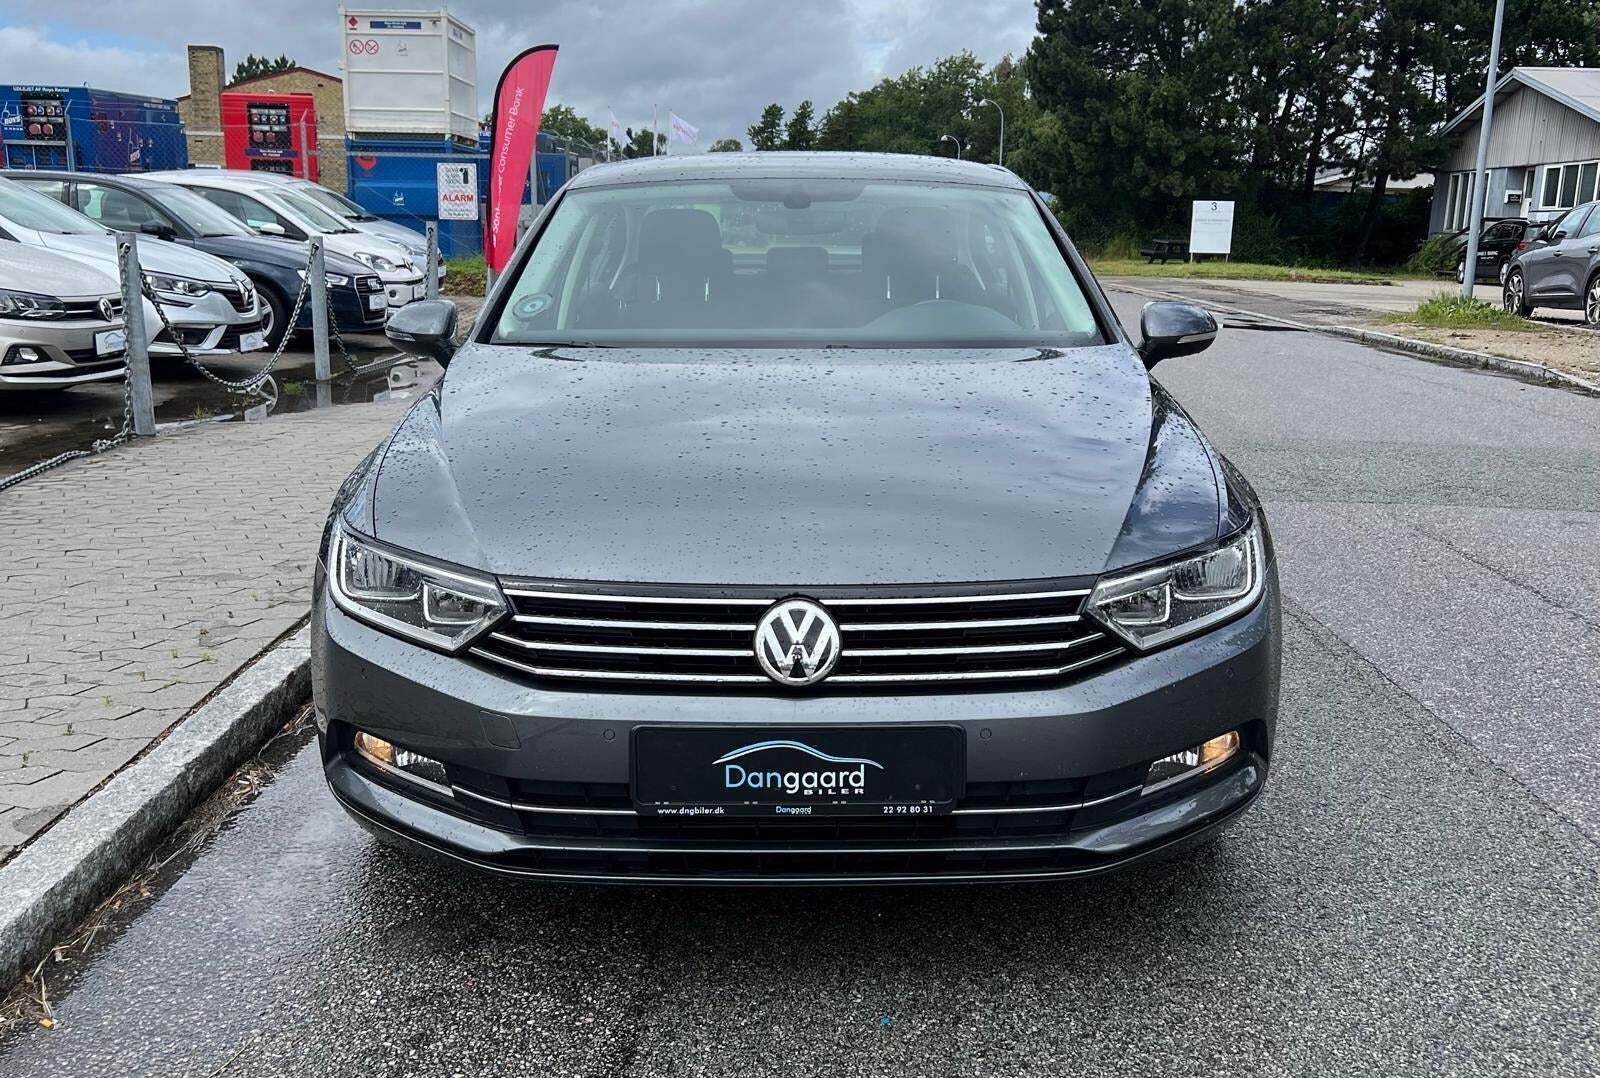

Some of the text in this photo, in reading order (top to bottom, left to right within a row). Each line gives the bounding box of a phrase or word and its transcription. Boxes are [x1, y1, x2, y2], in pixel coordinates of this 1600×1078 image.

[498, 116, 516, 173] Consumer
[509, 87, 525, 116] Bank
[443, 194, 474, 202] ALARM
[1210, 202, 1218, 211] 3
[725, 764, 865, 794] Dangaard
[657, 806, 725, 816] www.dngbiler.dk
[883, 805, 933, 814] 22 92 80 31
